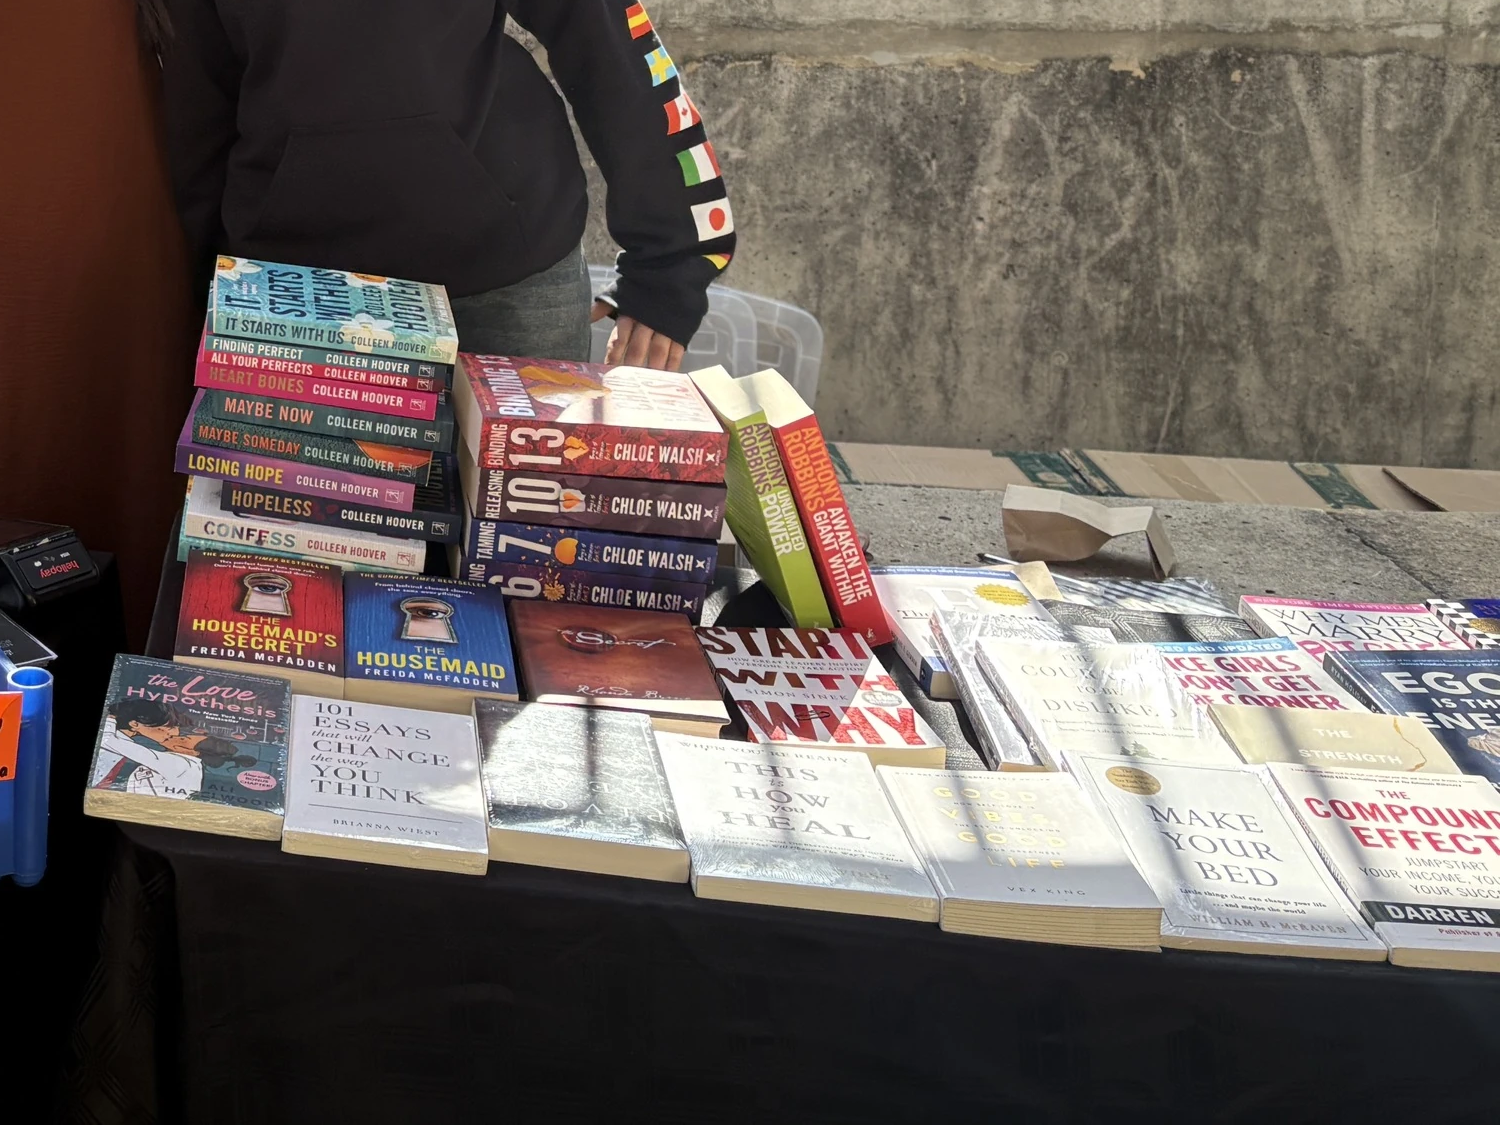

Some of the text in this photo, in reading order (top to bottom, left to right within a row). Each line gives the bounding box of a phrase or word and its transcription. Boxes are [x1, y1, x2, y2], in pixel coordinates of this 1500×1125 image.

[212, 338, 304, 360] FINDING PERFECT
[225, 317, 427, 355] IT STARTS WITH US COLLEEN HOOVER
[211, 352, 313, 376] ALL YOUR PERFECTS
[209, 367, 304, 393] HEART BONES
[224, 397, 314, 425] MAYBE NOW
[198, 424, 300, 456] MAYBE SOMEDAY
[488, 424, 704, 467] BINDING 13 CHLOE WALSH
[188, 454, 379, 498] LOSING HOPE COLLEEN HOOVER
[753, 422, 806, 551] ANTHONY UNLIMITED
[231, 489, 313, 517] HOPELESS
[485, 470, 562, 519] RELEASING 10
[739, 425, 793, 556] ROBBINS POWER
[203, 520, 296, 548] CONFESS
[813, 511, 857, 606] GIANT WITHIN
[827, 507, 872, 600] AWAKEN THE
[39, 560, 80, 579] hellopay
[250, 615, 281, 625] THE
[1263, 607, 1438, 628] WHY MEN
[192, 618, 338, 648] HOUSEMAID'S
[223, 634, 306, 655] SECRET
[697, 627, 869, 660] START
[1278, 620, 1449, 643] MARRY
[191, 646, 246, 660] FREIDA
[254, 653, 337, 673] McFADDEN
[414, 646, 445, 656] THE
[1213, 655, 1302, 673] GIRLS
[357, 651, 506, 679] HOUSEMAID
[148, 674, 256, 701] the Love
[715, 667, 900, 691] WITH
[1261, 675, 1322, 692] GET
[1380, 671, 1500, 695] EGO
[127, 686, 277, 718] Hypothesis
[745, 688, 848, 702] SIMON SINEK
[315, 702, 354, 717] 101
[314, 716, 432, 741] ESSAYS
[735, 700, 926, 746] WHY
[311, 729, 373, 744] that will
[311, 753, 368, 769] the way
[313, 740, 450, 768] CHANGE
[311, 764, 381, 783] YOU
[725, 761, 819, 782] THIS
[311, 779, 426, 805] THINK
[732, 785, 831, 809] HOW
[1375, 789, 1410, 800] THE
[332, 818, 440, 836] BRIANNA WIEST
[718, 810, 871, 841] HEAL
[1146, 804, 1264, 833] MAKE
[1160, 830, 1283, 863] YOUR
[1350, 825, 1500, 856] EFFECT
[1194, 860, 1279, 887] BED
[1406, 856, 1489, 872] JUMPSTART
[1007, 886, 1037, 894] VEX
[1385, 905, 1495, 925] DARREN
